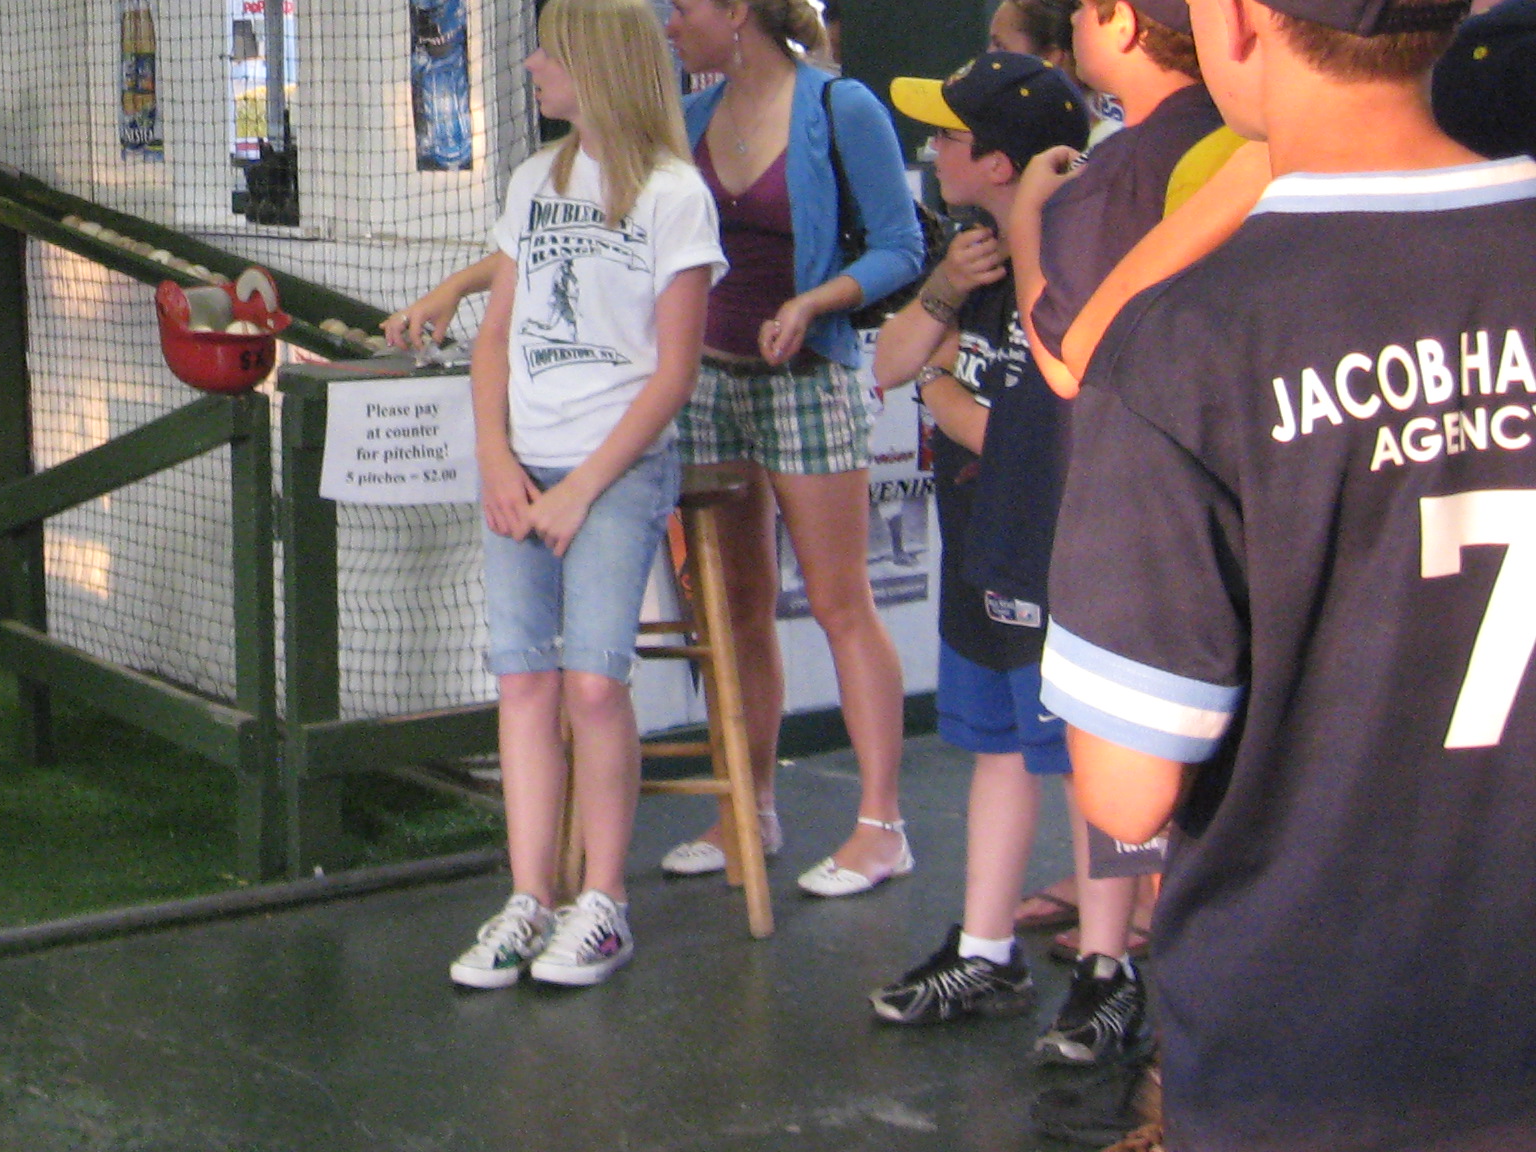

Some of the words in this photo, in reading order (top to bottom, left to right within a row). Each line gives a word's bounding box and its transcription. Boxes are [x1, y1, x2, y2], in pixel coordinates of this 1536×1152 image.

[529, 199, 627, 232] DOUBLEDY
[1271, 338, 1455, 443] JACOB
[366, 403, 410, 418] Please
[415, 403, 439, 418] pay
[366, 428, 380, 440] at
[385, 425, 440, 439] counter
[1370, 405, 1536, 472] AGENC
[356, 446, 380, 461] for
[384, 442, 449, 464] pitching!
[346, 471, 354, 484] 5
[358, 471, 406, 486] pitches
[423, 468, 457, 483] $2.00
